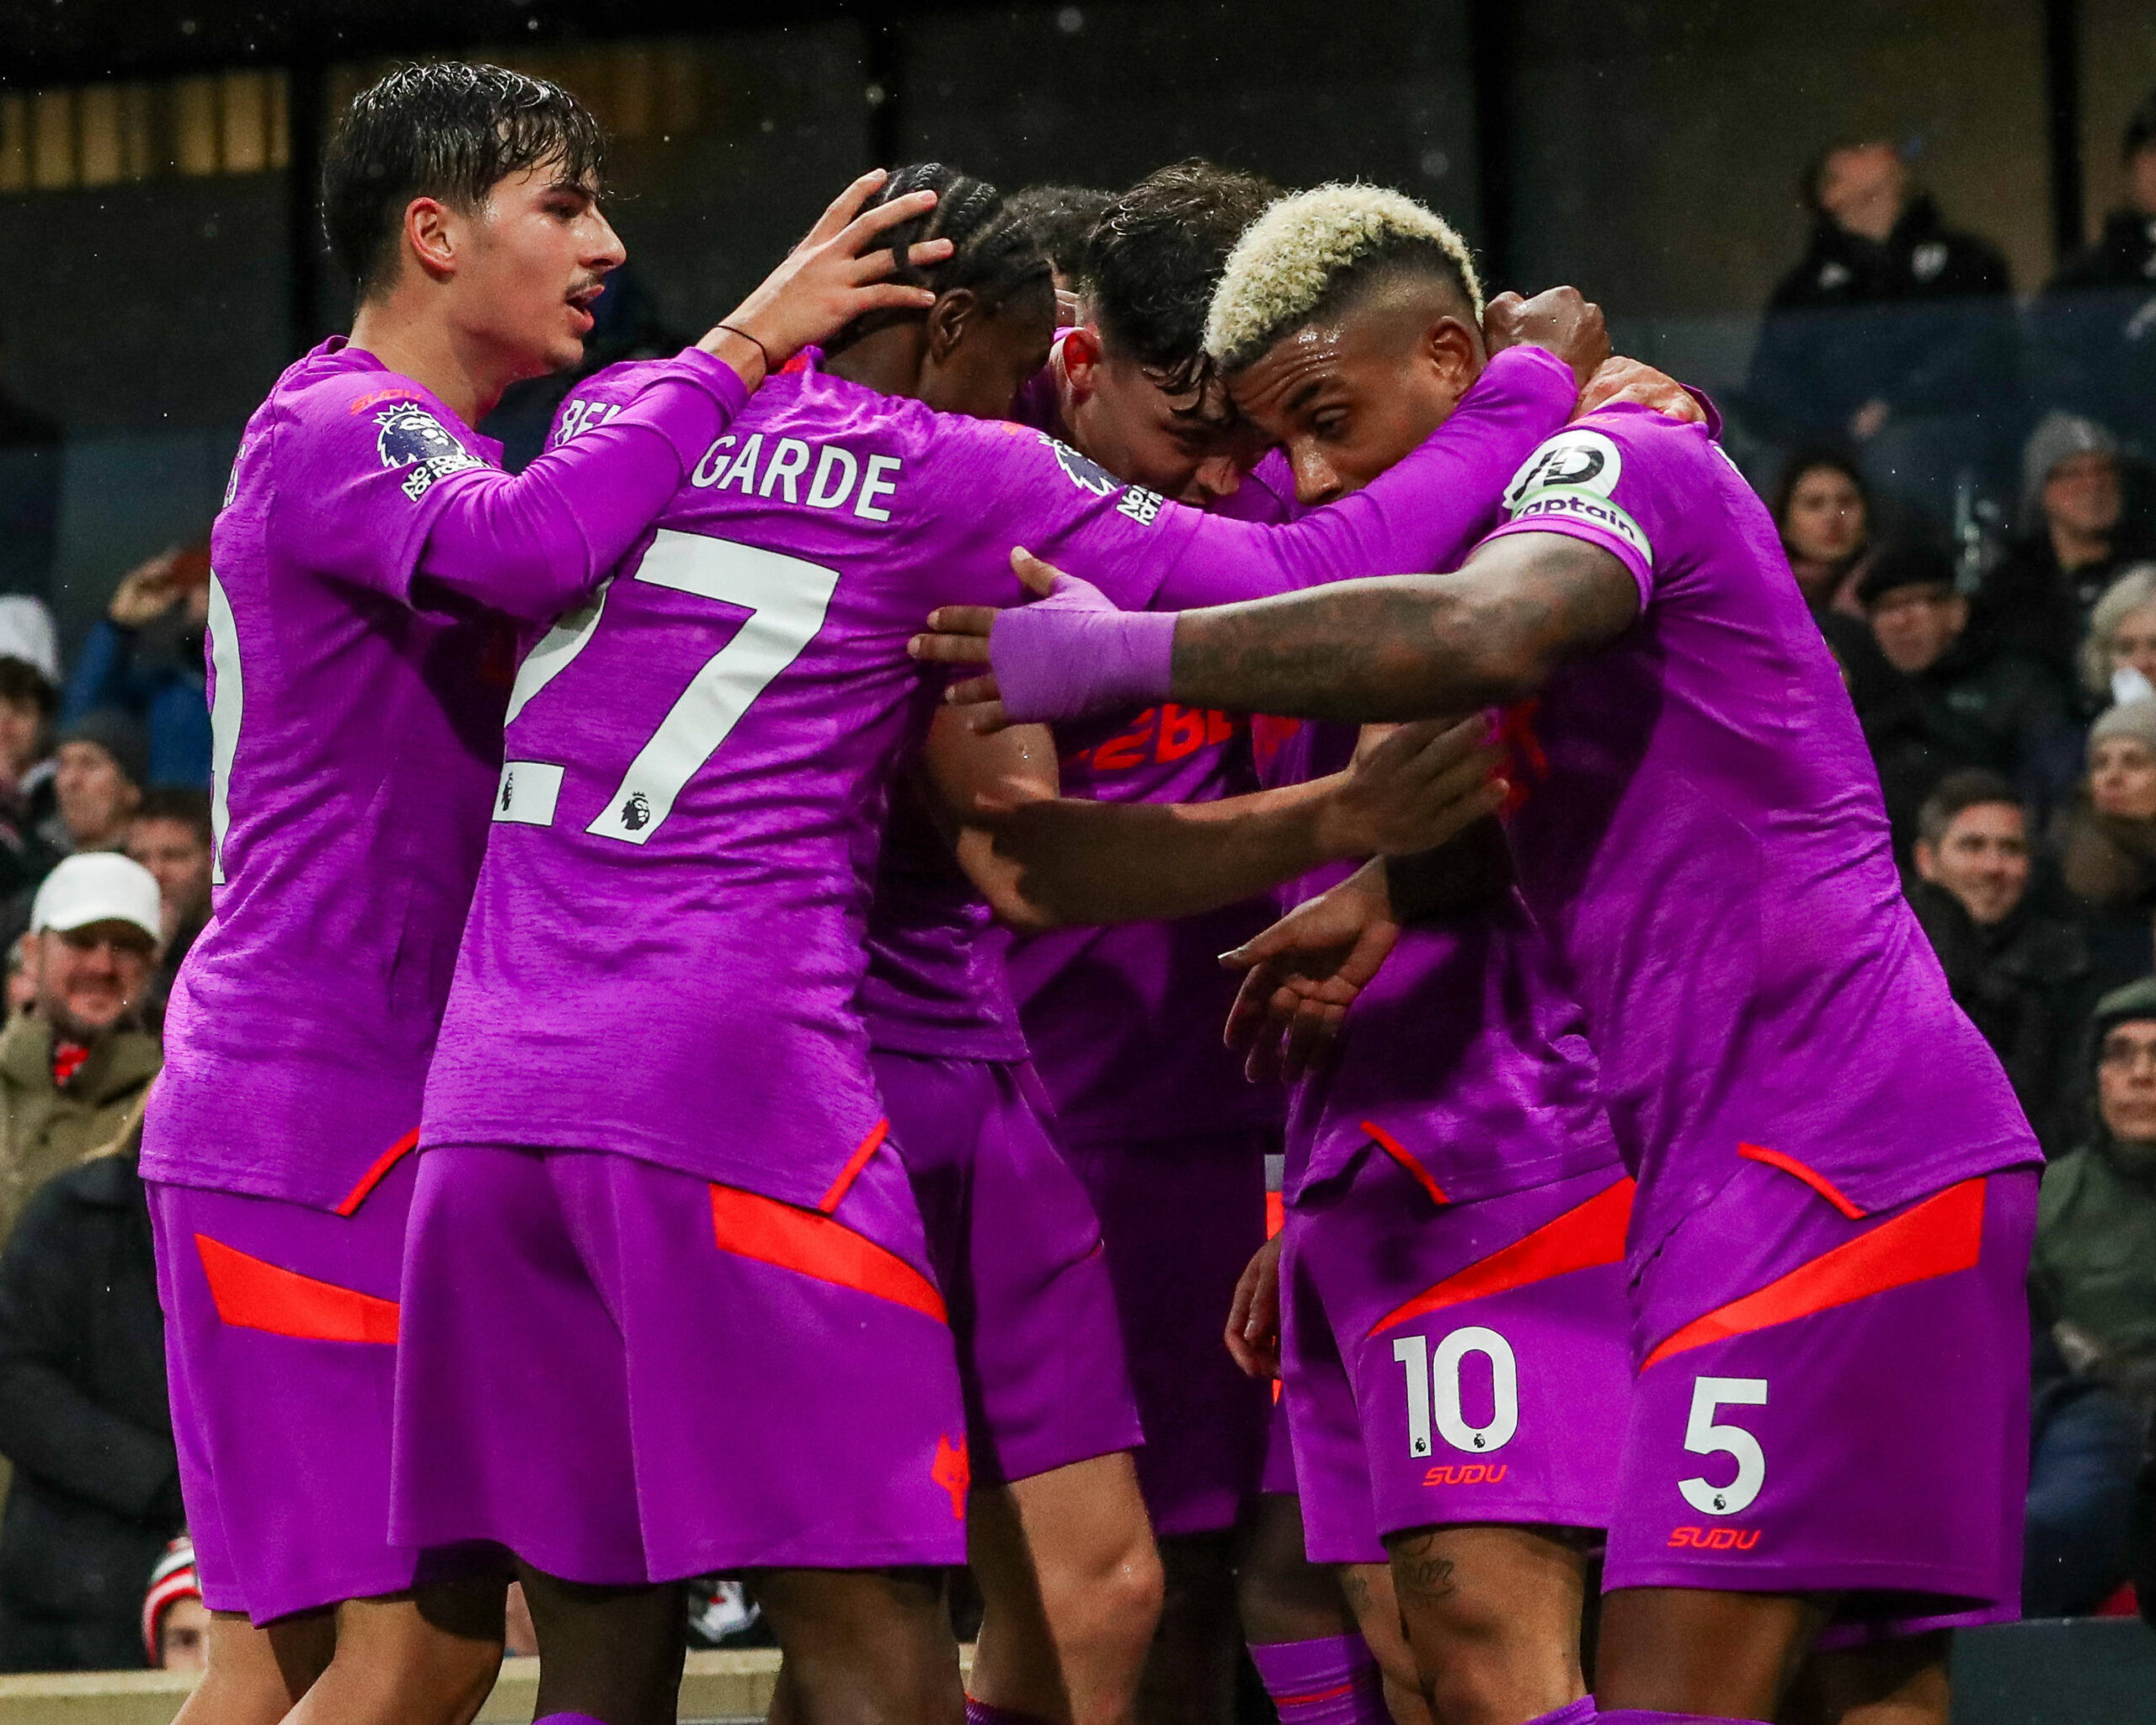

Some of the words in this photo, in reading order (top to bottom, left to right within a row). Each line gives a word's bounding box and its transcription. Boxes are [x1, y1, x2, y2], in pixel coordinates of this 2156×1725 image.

[1393, 1326, 1519, 1459] 10
[1422, 1463, 1508, 1487] SUDU
[1677, 1375, 1769, 1517] 5
[1667, 1525, 1762, 1550] SUDU
